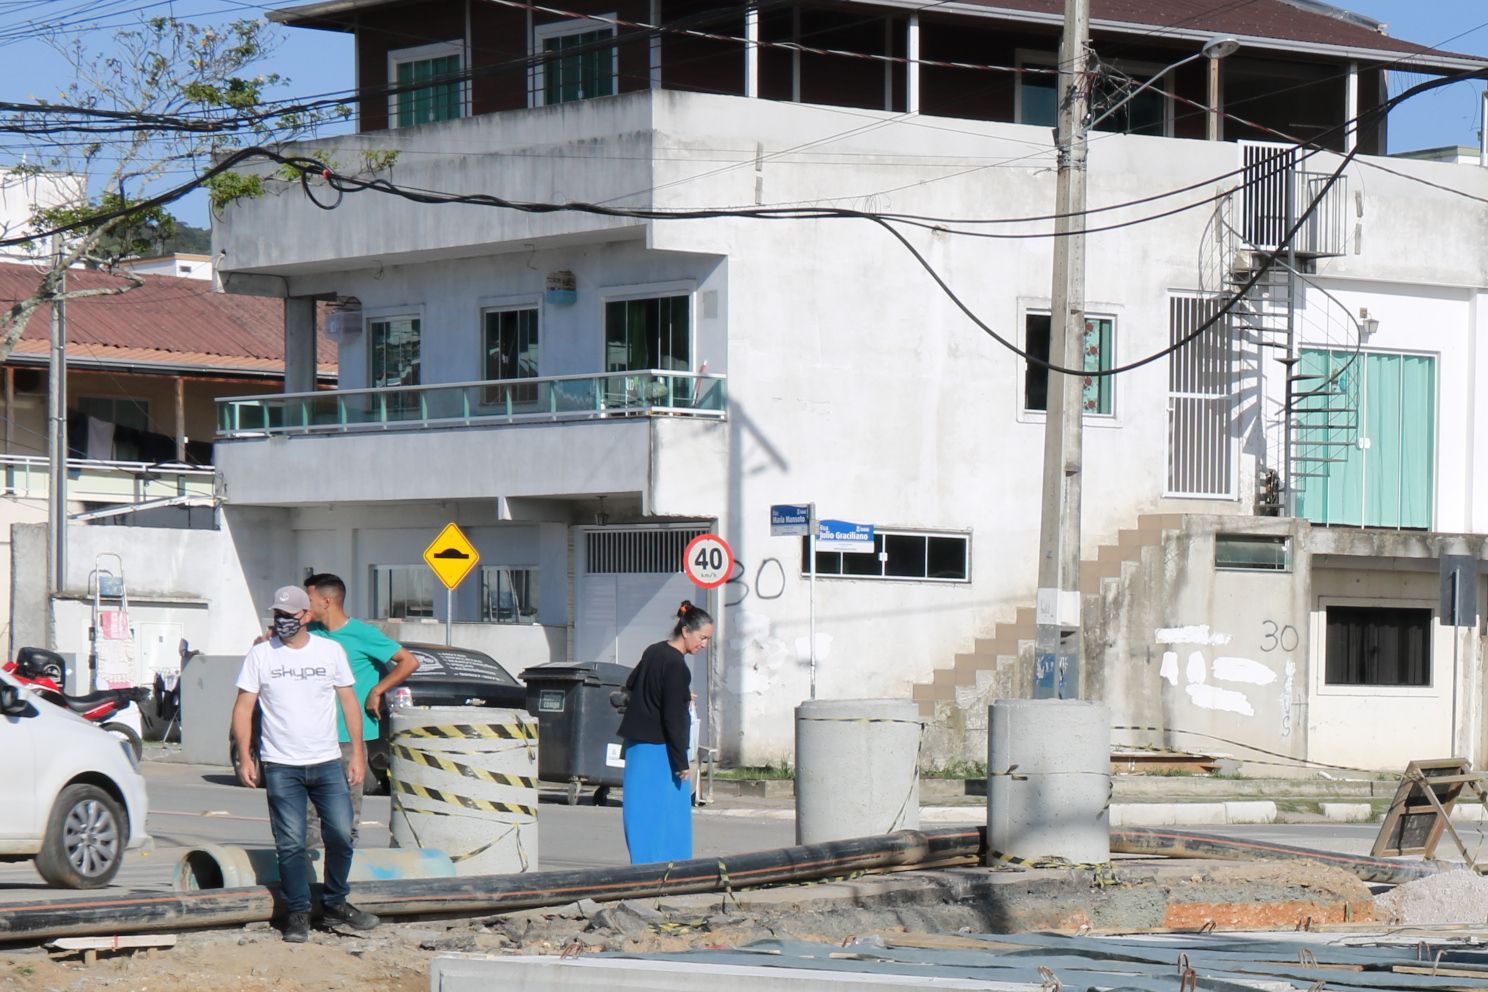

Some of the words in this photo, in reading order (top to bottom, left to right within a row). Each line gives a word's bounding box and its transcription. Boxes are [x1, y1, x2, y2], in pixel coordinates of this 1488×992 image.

[835, 531, 869, 541] Graciliano
[694, 547, 723, 571] 40
[1260, 620, 1300, 653] 30
